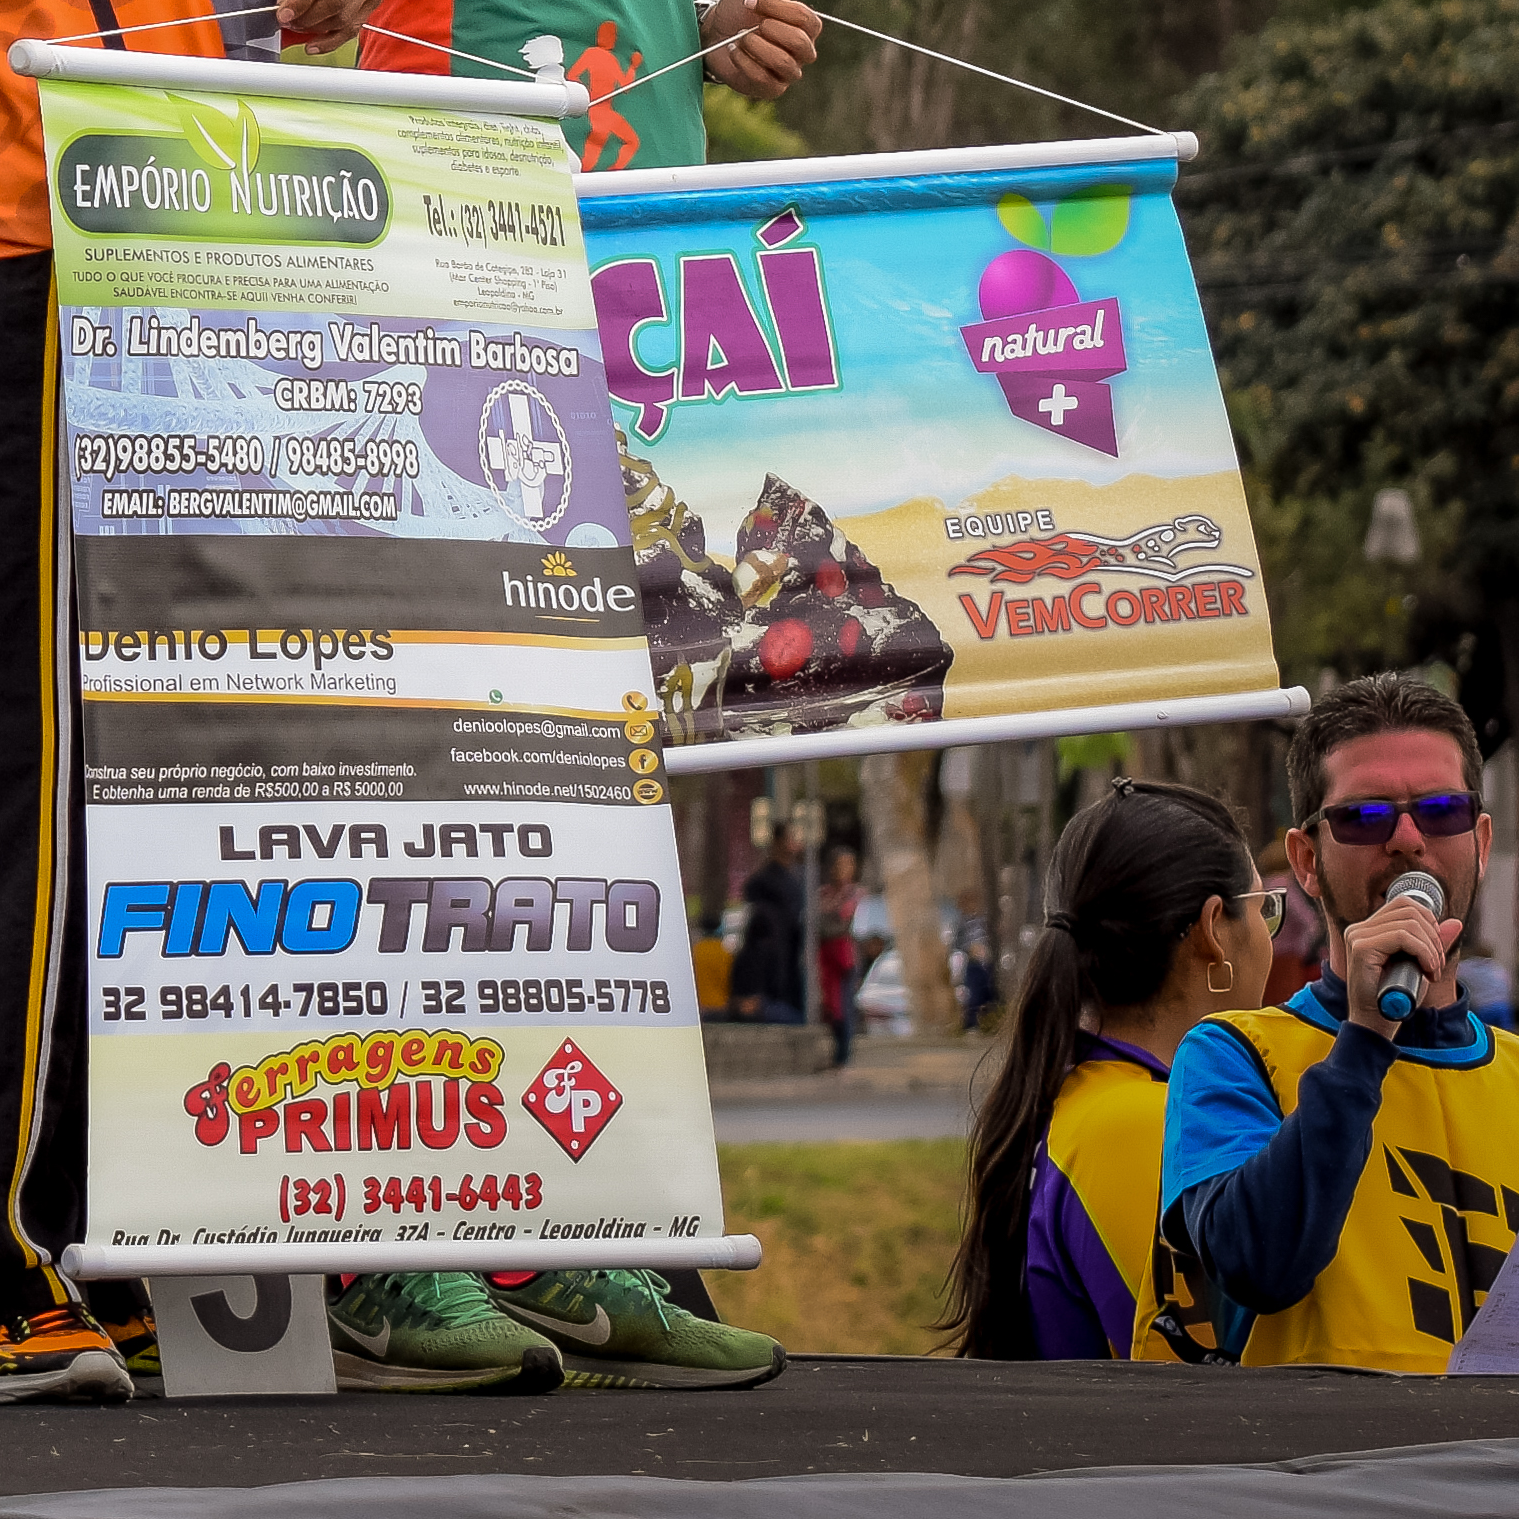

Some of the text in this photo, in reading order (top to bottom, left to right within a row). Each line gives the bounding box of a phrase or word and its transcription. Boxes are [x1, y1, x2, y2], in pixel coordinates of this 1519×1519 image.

[74, 155, 378, 223] EMPÓRIO NUTRIÇÃO
[423, 194, 566, 249] Tel.: (32) 3441-4521
[85, 248, 375, 271] SUPLEMENTOS E PRODUTOS ALIMENTARES
[72, 271, 390, 293] TUDO O QUE VOCÊ PROCURA E PRECISA PARA UMA ALIMENTAÇÃO
[113, 285, 169, 298] SAUDÁVEL
[171, 289, 237, 301] ENCONTRA-SE
[271, 292, 305, 303] VENHA
[590, 207, 838, 440] ÇAÍ
[980, 308, 1106, 364] natural
[71, 316, 580, 378] Dr. Lindemberg Valentim Barbosa
[273, 378, 423, 415] CRBM: 7293
[74, 435, 264, 481] (32)98855-5480
[286, 439, 421, 478] 98485-8998
[102, 490, 397, 522] EMAIL: BERGVALENTIM@GMAIL.COM
[945, 508, 1054, 540] EQUIPE
[503, 570, 636, 612] hinode
[248, 624, 395, 671] Lopes
[82, 672, 397, 695] Profissional em Network Marketing
[130, 761, 418, 783] seu próprio negócio, com baixo investimento.
[450, 747, 626, 770] facebook.com/deniolopes
[93, 781, 405, 800] E obtenha uma renda de R$500,00 a R$ 5000,00
[463, 783, 632, 801] www.hinode.net/1502460
[219, 823, 553, 860] LAVA JATO
[97, 877, 662, 957] FINO TRATO
[102, 986, 147, 1021] 32
[160, 982, 389, 1019] 98414-7850
[422, 980, 466, 1015] 32
[478, 978, 672, 1015] 98805-5778
[184, 1028, 505, 1146] Ferragens
[240, 1078, 508, 1154] PRIMUS
[278, 1172, 544, 1223] (32) 3441-6443
[111, 1229, 151, 1246] Rua
[192, 1223, 278, 1244] Custódio
[282, 1224, 383, 1244] Junqueira
[451, 1221, 517, 1242] Centro
[538, 1217, 648, 1240] Leopoldina
[667, 1215, 702, 1239] MG
